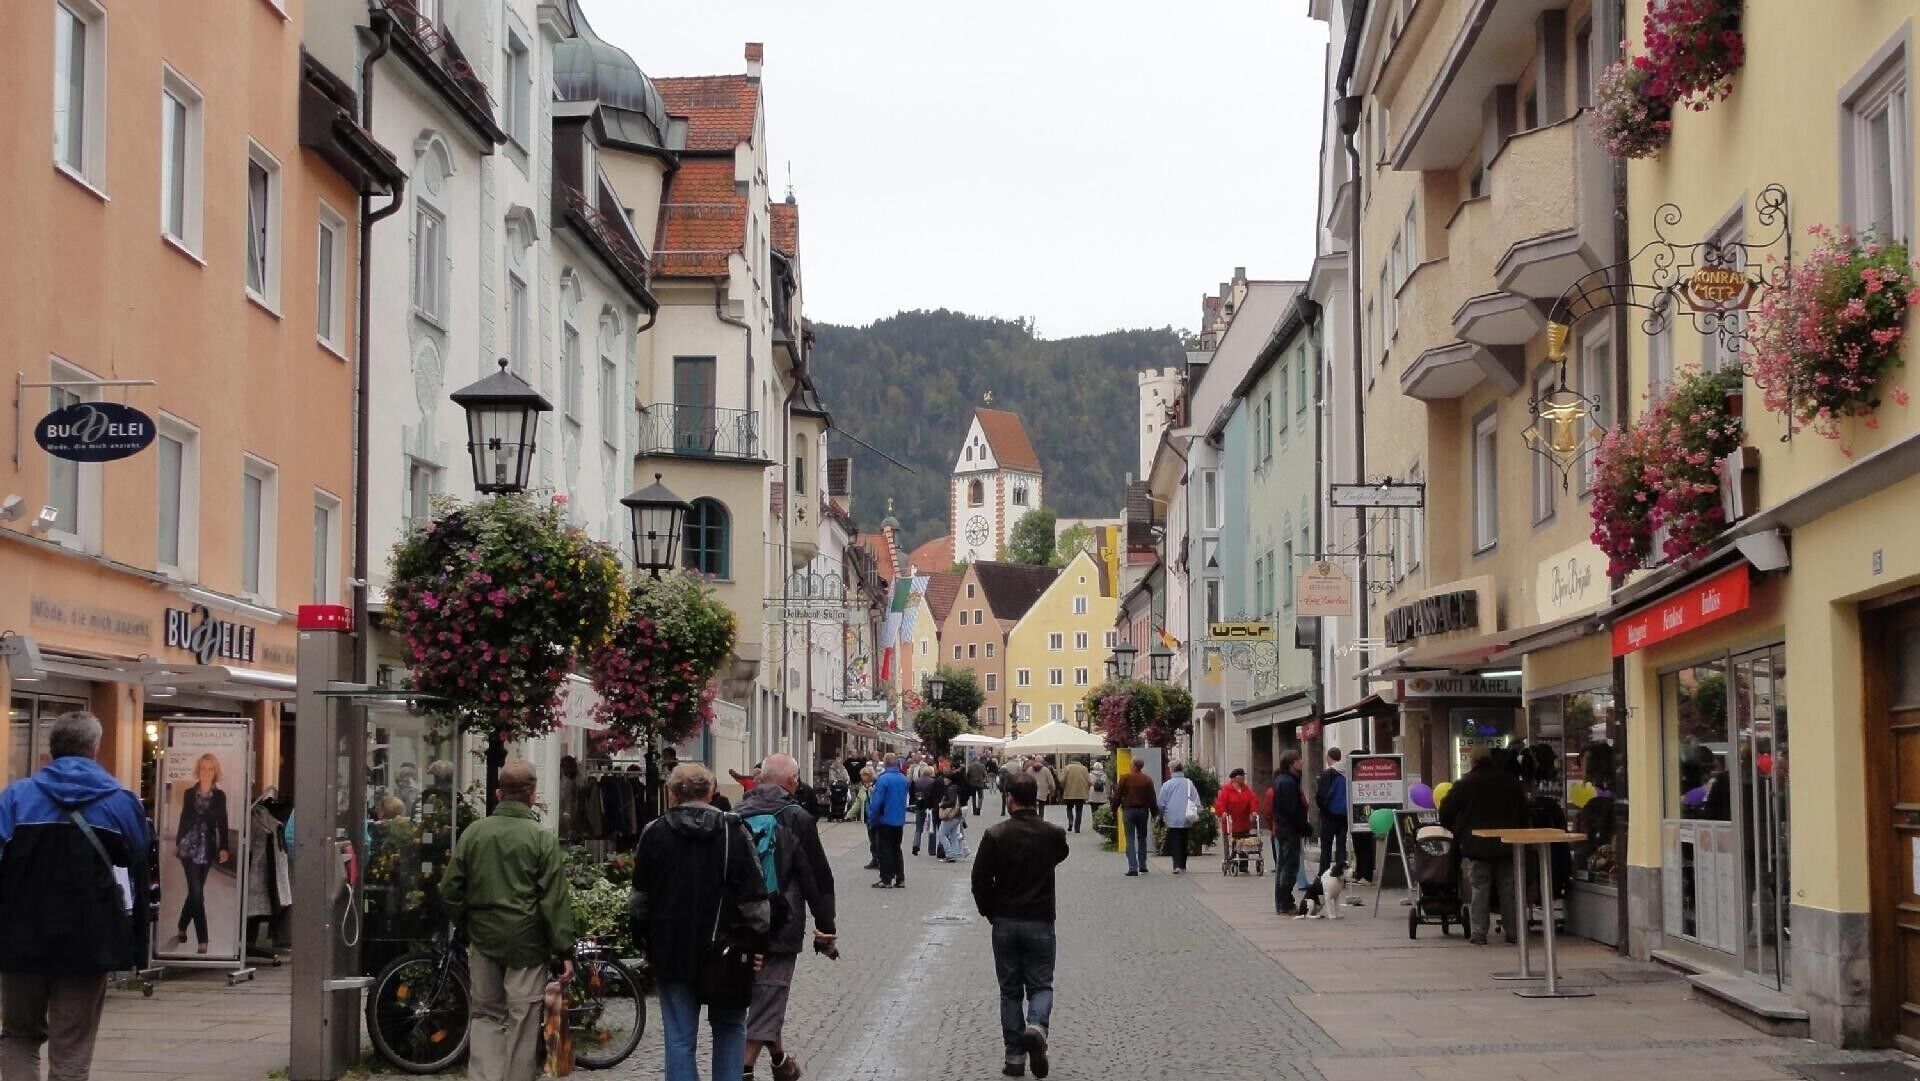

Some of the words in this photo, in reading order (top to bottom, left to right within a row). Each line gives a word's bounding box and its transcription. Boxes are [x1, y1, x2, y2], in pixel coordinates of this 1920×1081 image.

[1212, 626, 1271, 637] WOLF
[1433, 679, 1464, 693] MOTI
[1470, 679, 1513, 694] MAHEL
